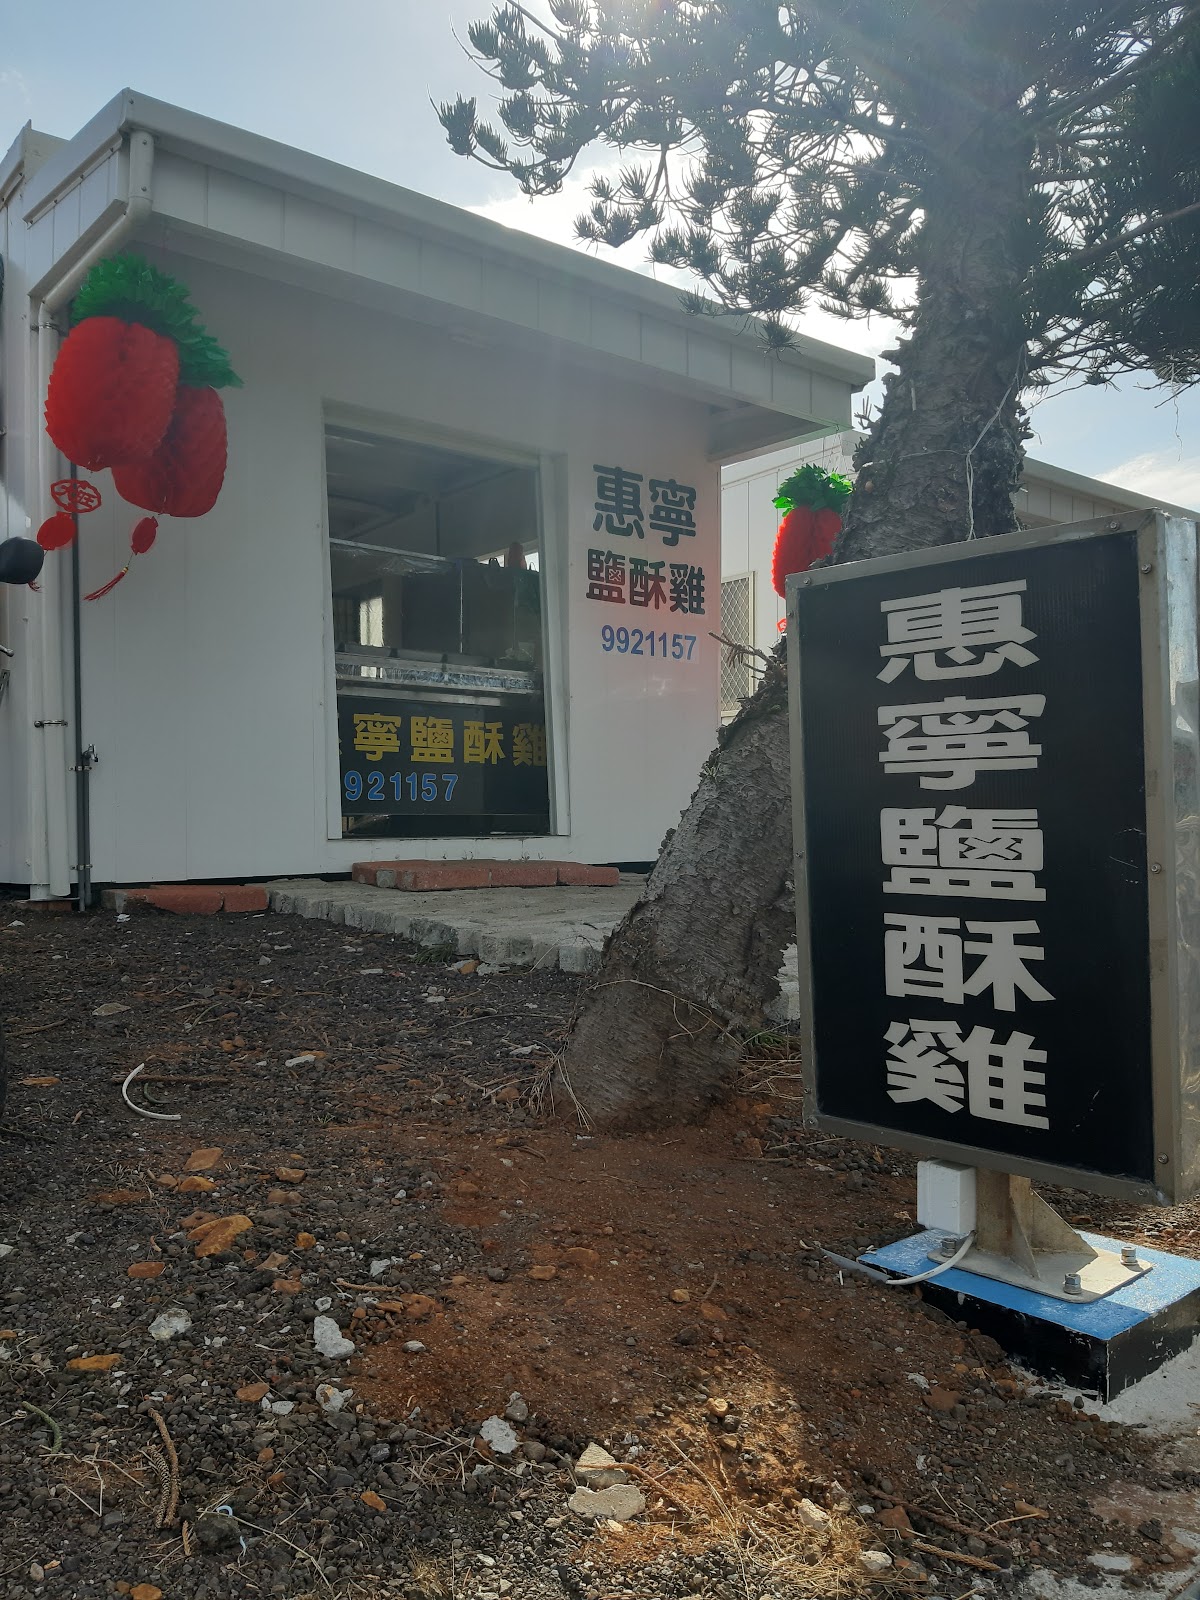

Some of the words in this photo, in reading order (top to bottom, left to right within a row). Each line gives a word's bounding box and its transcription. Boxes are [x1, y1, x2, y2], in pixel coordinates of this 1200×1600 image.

[593, 464, 697, 547] 惠寧
[586, 548, 706, 615] 鹽酥雞
[601, 624, 697, 660] 9921157
[338, 712, 547, 767] 寧鹽酥雞
[344, 770, 459, 801] 921157
[876, 579, 1056, 1130] 惠寧鹽酥雞
